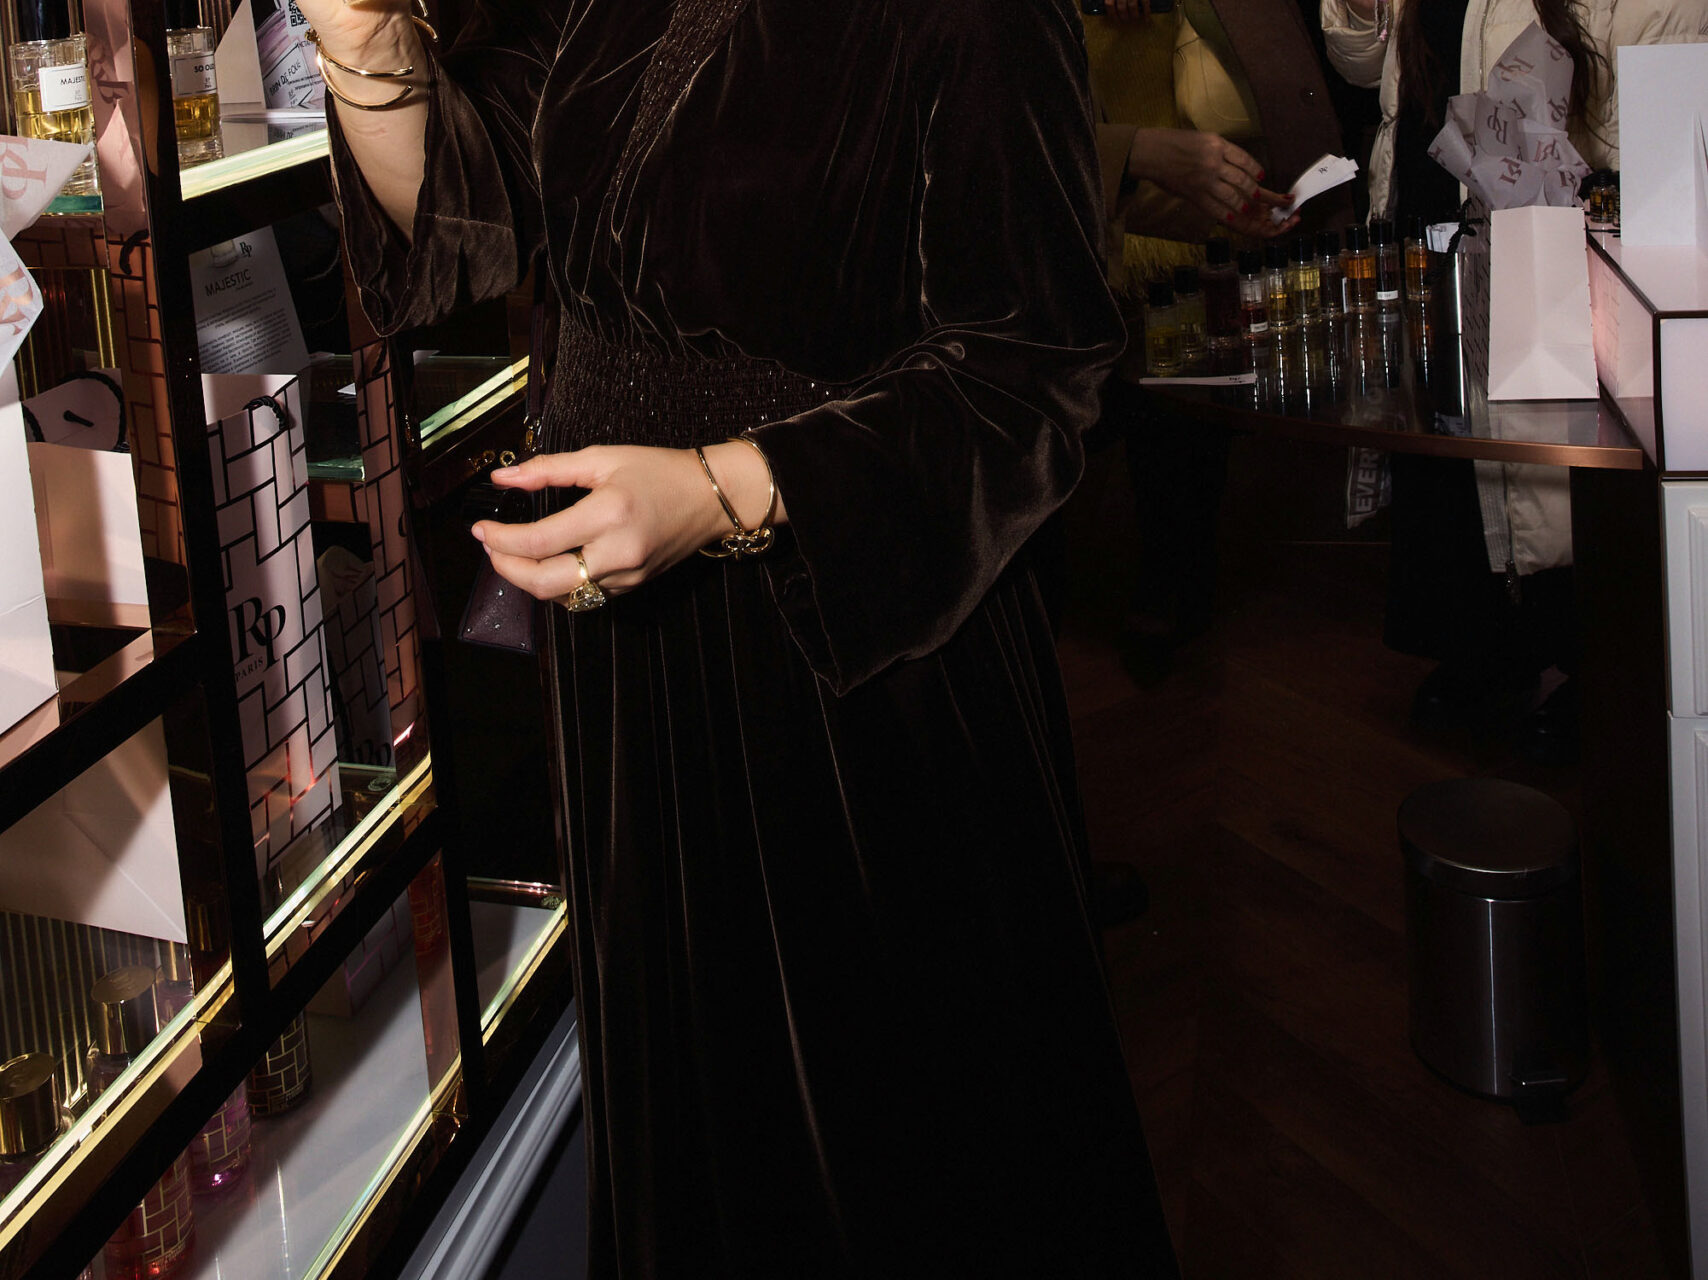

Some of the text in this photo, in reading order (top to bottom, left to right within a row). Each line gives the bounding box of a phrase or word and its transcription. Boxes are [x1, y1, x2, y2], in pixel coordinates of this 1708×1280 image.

[194, 65, 204, 73] SO
[205, 269, 251, 297] MAJESTIC
[1355, 448, 1378, 512] EVER
[235, 657, 264, 682] PARIS
